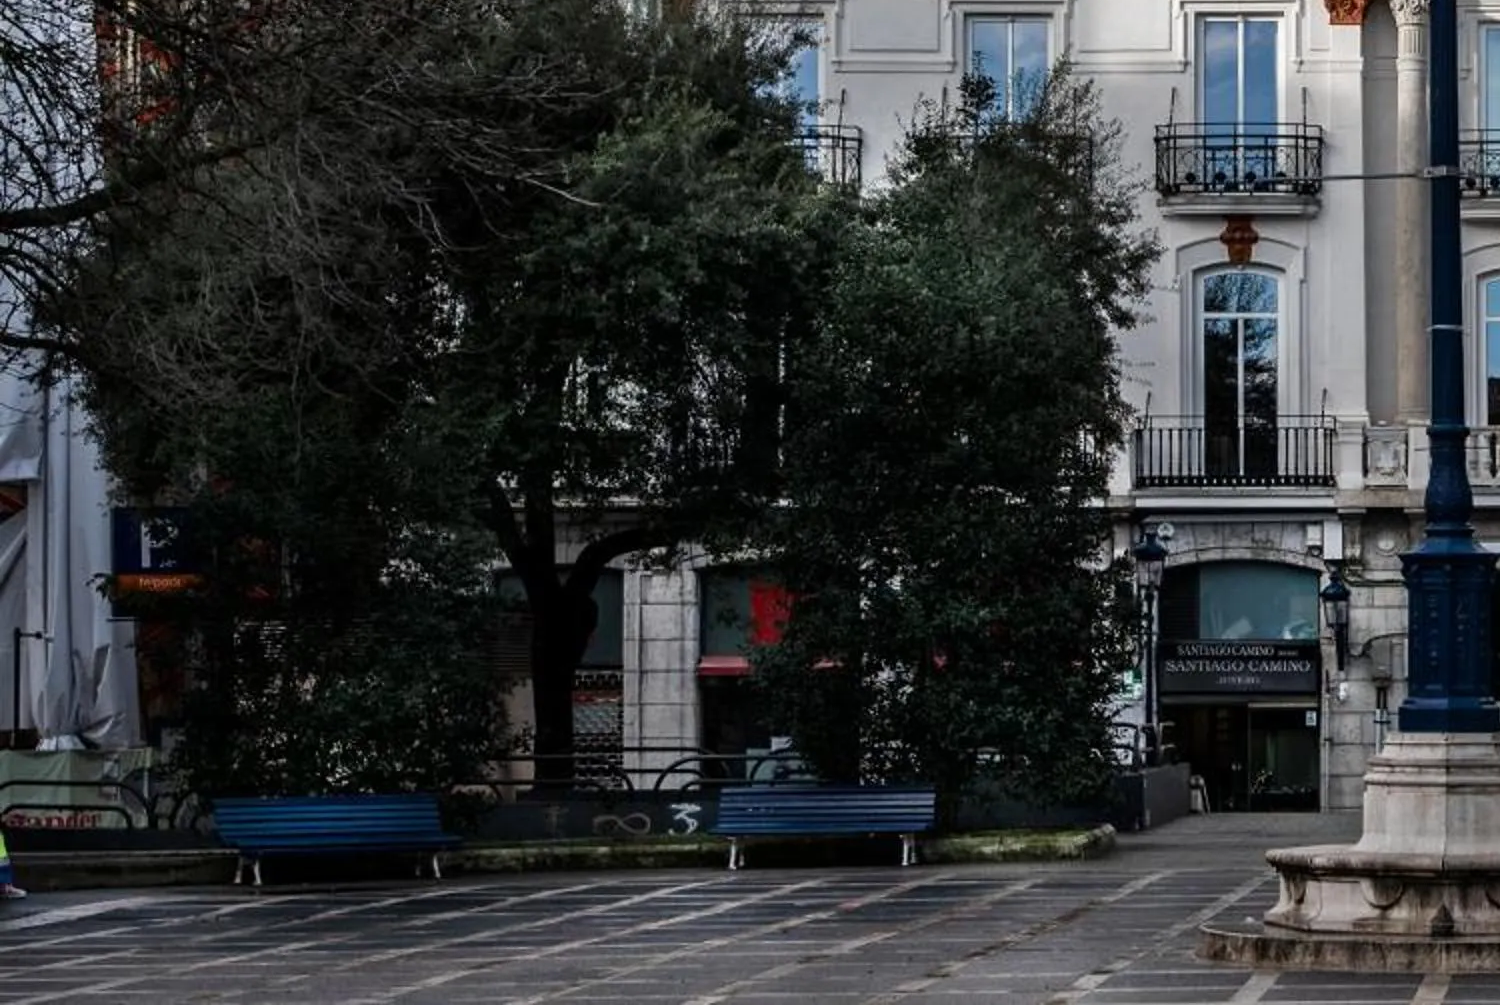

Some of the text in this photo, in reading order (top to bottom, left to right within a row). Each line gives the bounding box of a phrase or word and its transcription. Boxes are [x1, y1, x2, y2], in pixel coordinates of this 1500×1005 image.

[1176, 644, 1231, 657] SANTIAGO
[1231, 644, 1275, 657] CAMINO
[1165, 659, 1311, 673] SANTIAGO CAMINO
